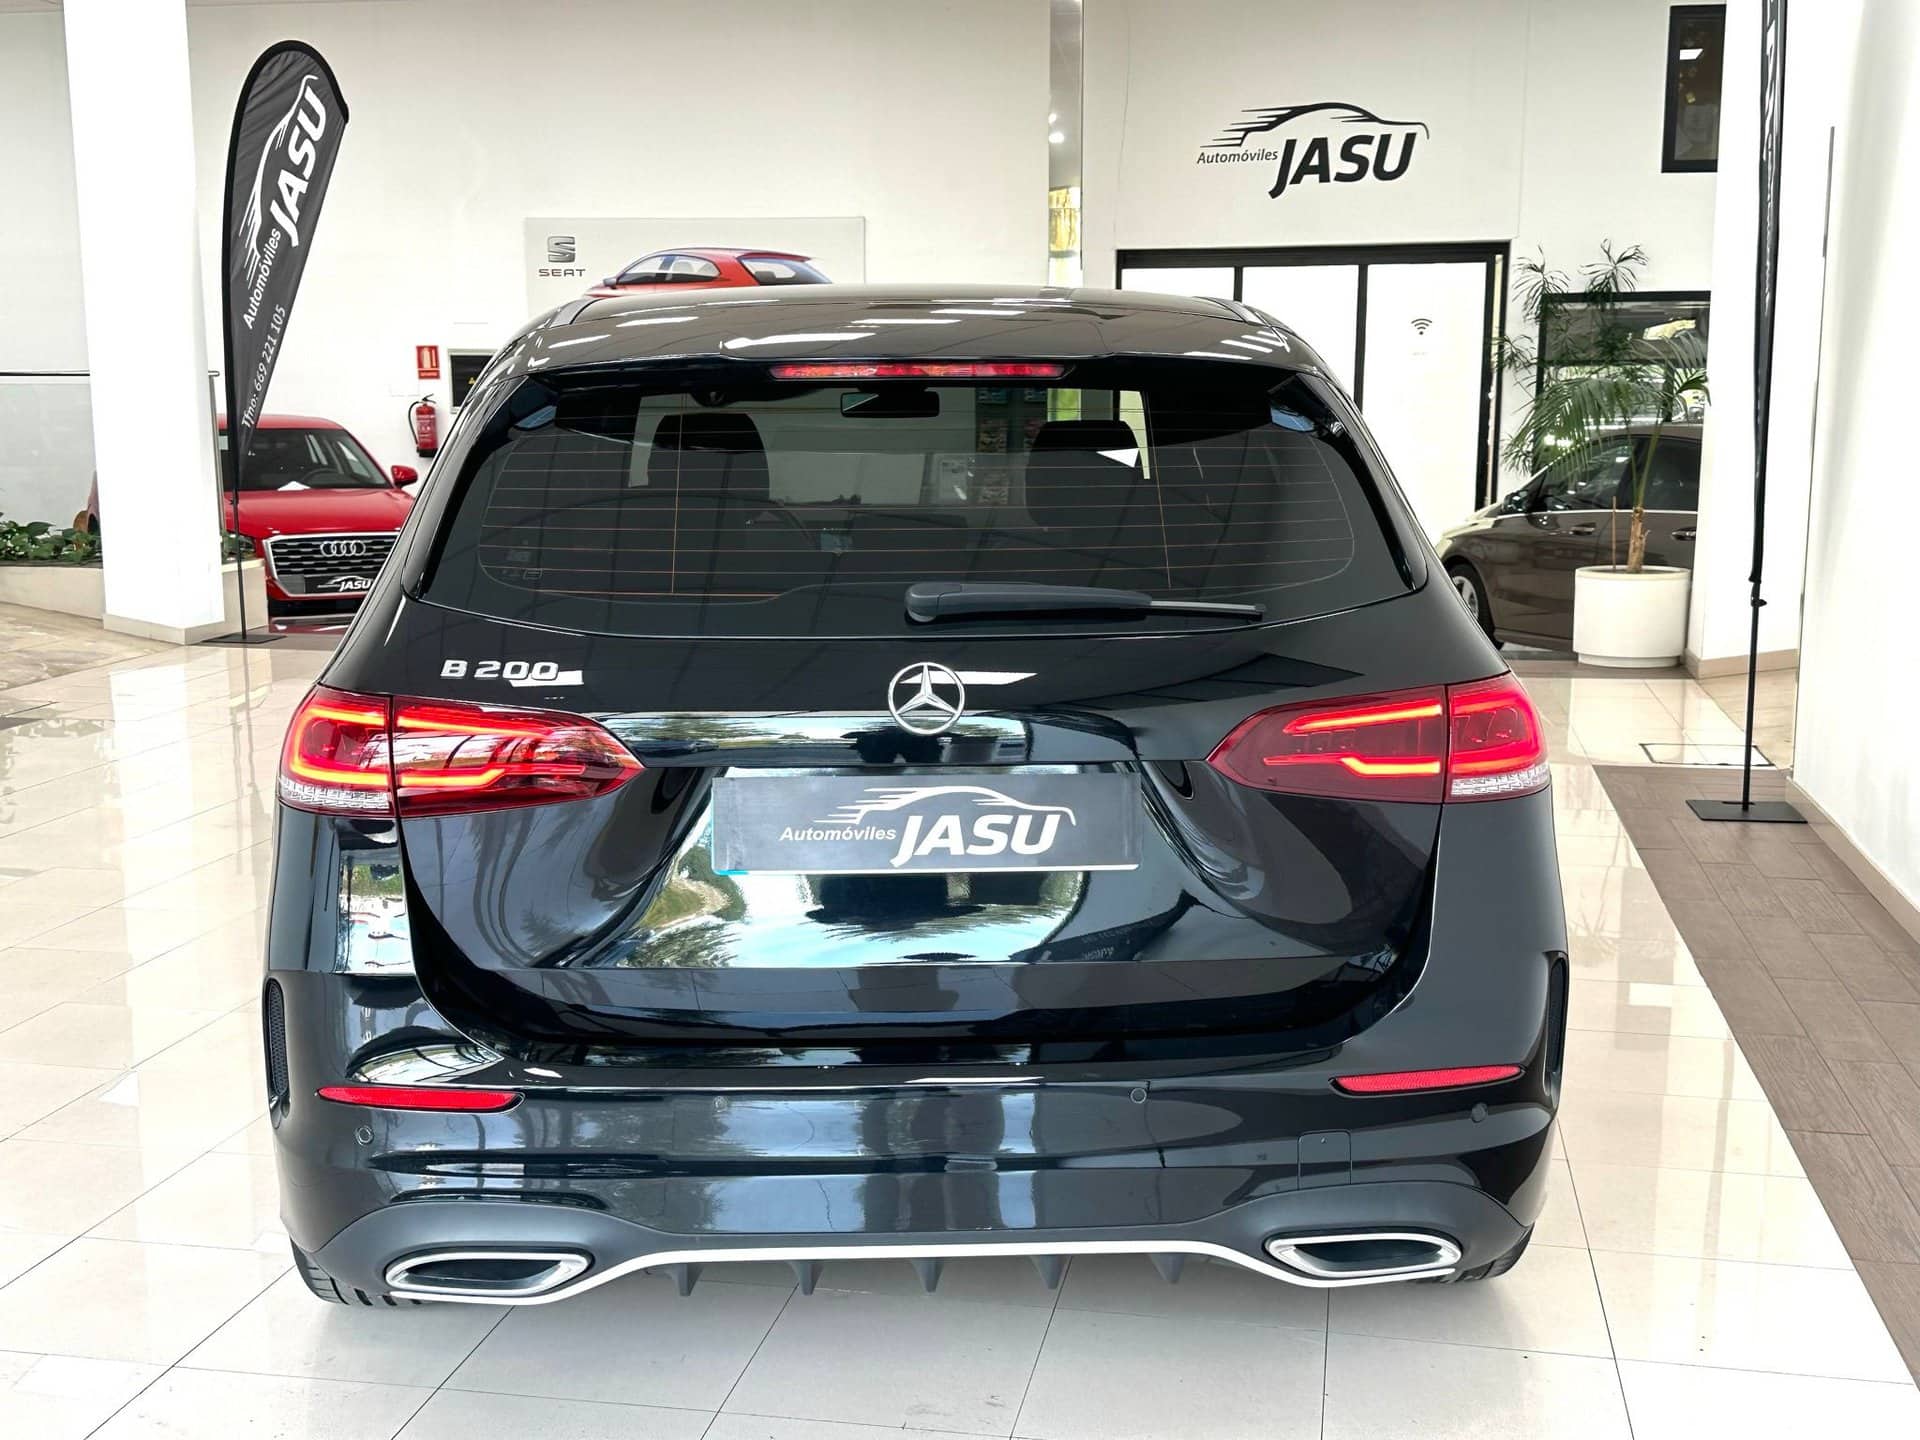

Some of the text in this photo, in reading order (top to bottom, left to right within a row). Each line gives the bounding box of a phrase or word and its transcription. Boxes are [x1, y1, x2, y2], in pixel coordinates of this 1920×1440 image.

[270, 85, 327, 248] JASU
[1196, 132, 1418, 200] Automóviles JASU
[242, 228, 282, 330] Automóviles
[538, 268, 586, 277] SEAT
[241, 304, 286, 428] Tfno: 669 221 105
[339, 580, 372, 593] JASU
[440, 659, 559, 680] B 200
[779, 814, 1062, 868] Automóviles JASU
